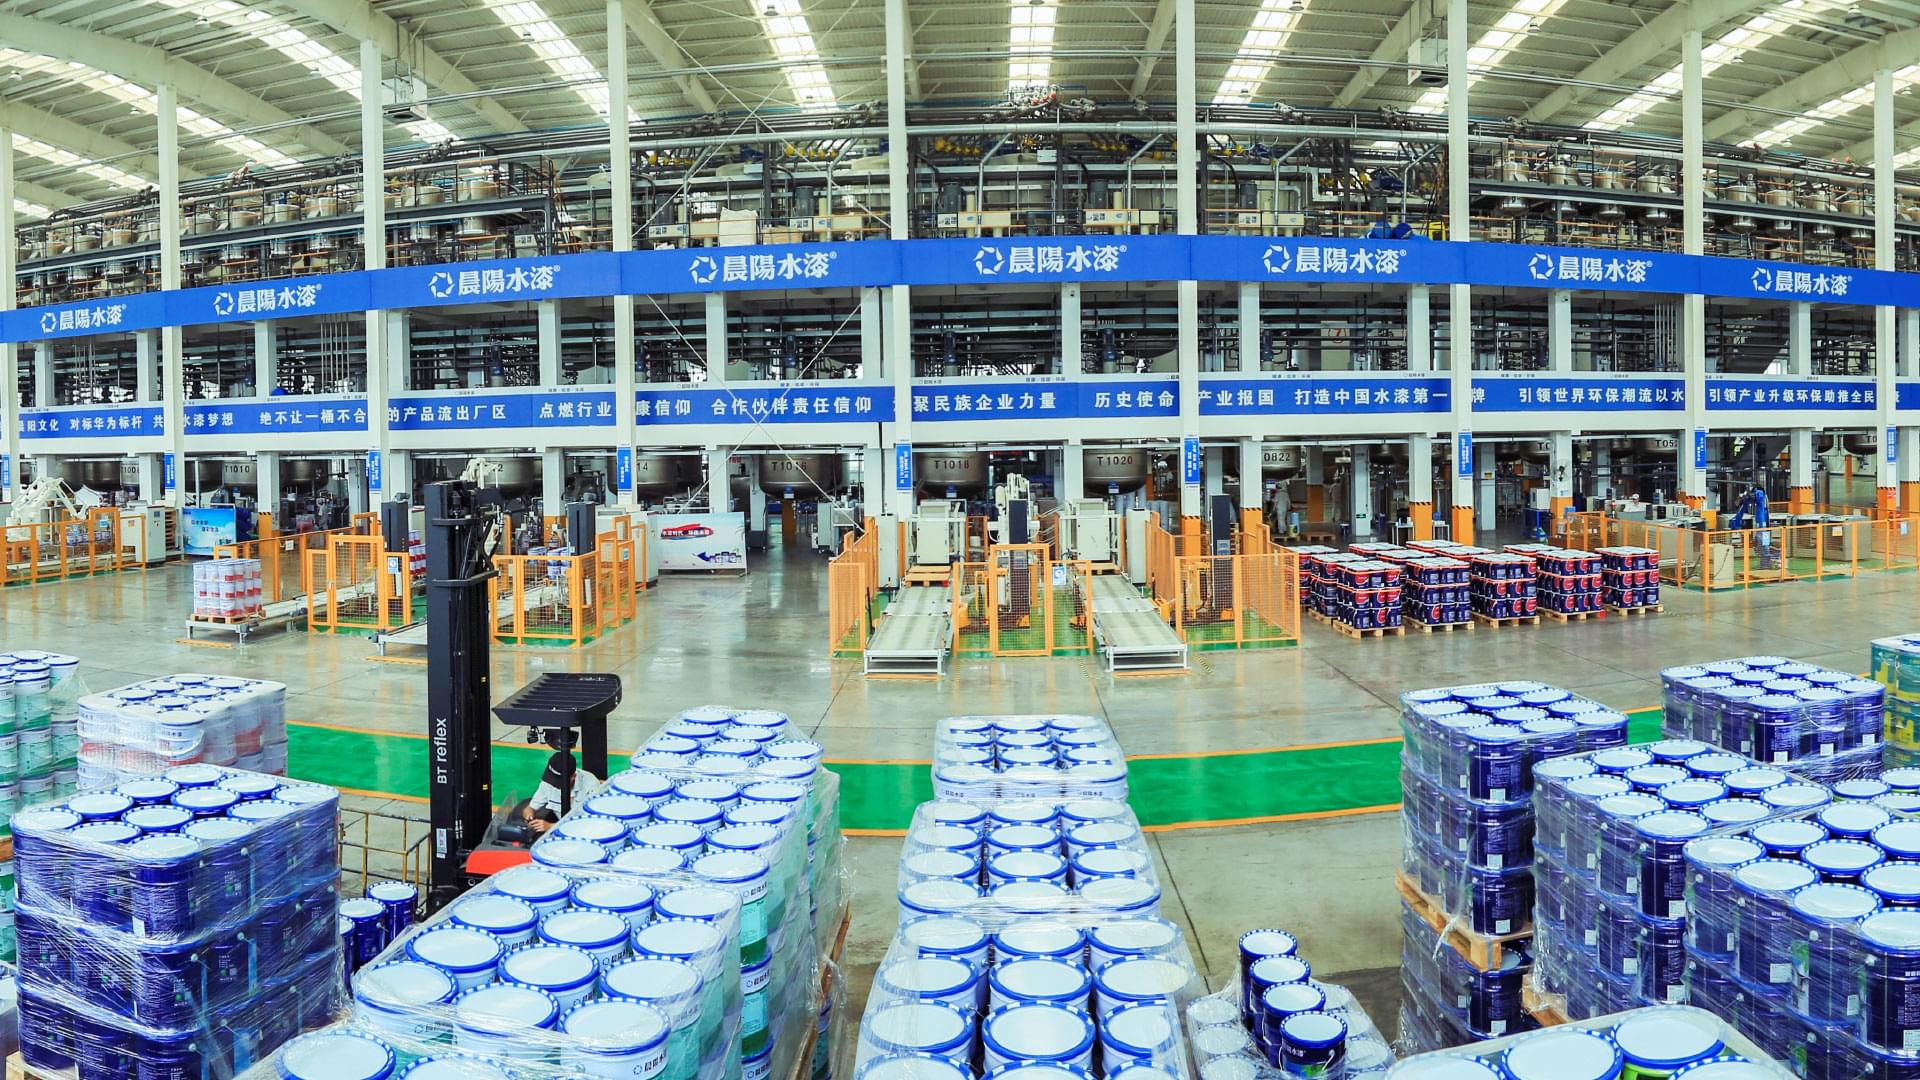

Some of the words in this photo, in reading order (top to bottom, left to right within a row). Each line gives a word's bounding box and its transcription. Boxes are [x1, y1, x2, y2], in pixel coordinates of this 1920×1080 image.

[1096, 456, 1133, 466] T1020
[224, 465, 250, 474] T1010
[434, 718, 447, 762] reflex
[437, 766, 448, 784] BT
